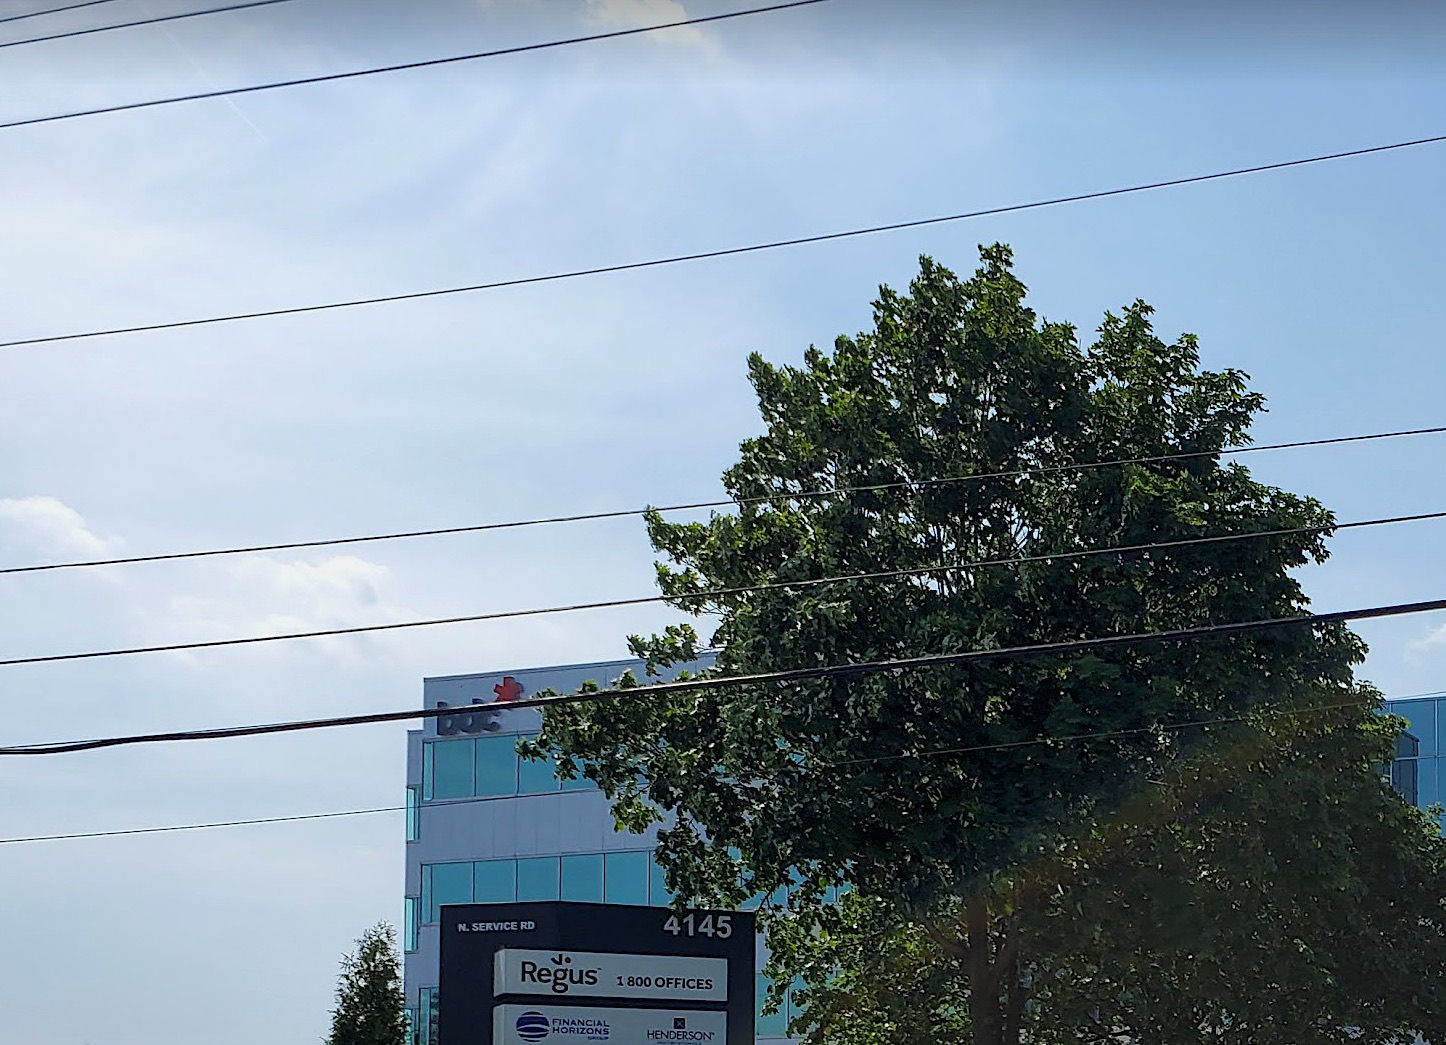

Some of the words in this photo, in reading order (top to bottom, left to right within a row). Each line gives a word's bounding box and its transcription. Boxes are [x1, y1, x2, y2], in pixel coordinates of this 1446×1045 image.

[457, 923, 470, 932] N.
[471, 921, 519, 932] SERVICE
[520, 920, 535, 930] RD
[663, 913, 732, 939] 4145
[520, 955, 599, 994] Regus
[616, 975, 625, 987] 1
[626, 976, 652, 988] 800
[654, 976, 714, 990] OFFICES
[552, 1017, 610, 1028] FINANCIAL
[552, 1026, 610, 1036] HORIZONS
[646, 1029, 713, 1041] HENDERSON
